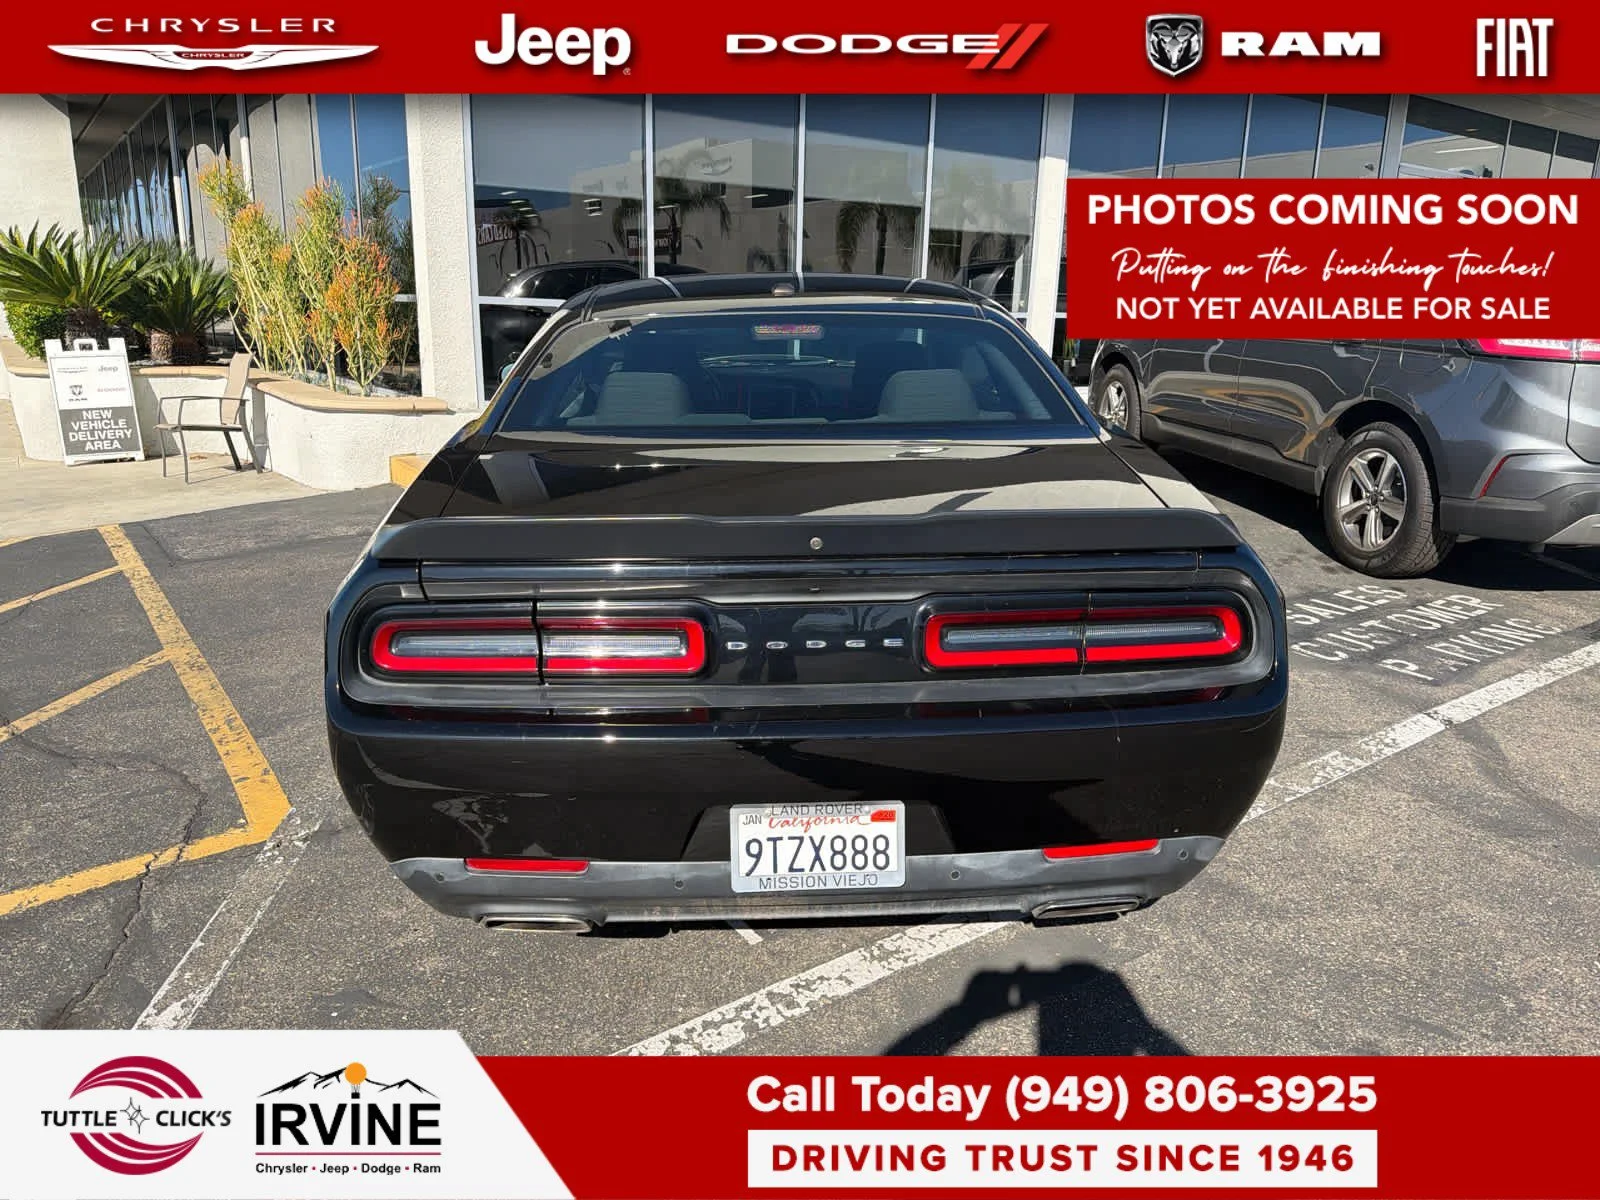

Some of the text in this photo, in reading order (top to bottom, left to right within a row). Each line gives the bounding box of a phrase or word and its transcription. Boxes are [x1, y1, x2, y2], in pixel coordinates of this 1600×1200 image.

[82, 409, 113, 420] NEW
[71, 419, 128, 431] VEHICLE
[68, 429, 133, 442] DELIVERY
[85, 440, 122, 452] AREA
[1286, 585, 1408, 625] SALES
[1290, 594, 1505, 661] CUSTOMER
[726, 637, 905, 651] DODGE
[771, 803, 864, 816] LAND ROVER
[742, 815, 762, 826] JAN
[768, 814, 872, 833] California
[745, 834, 890, 877] 9TZX888
[759, 873, 879, 890] MISSION VIEJO
